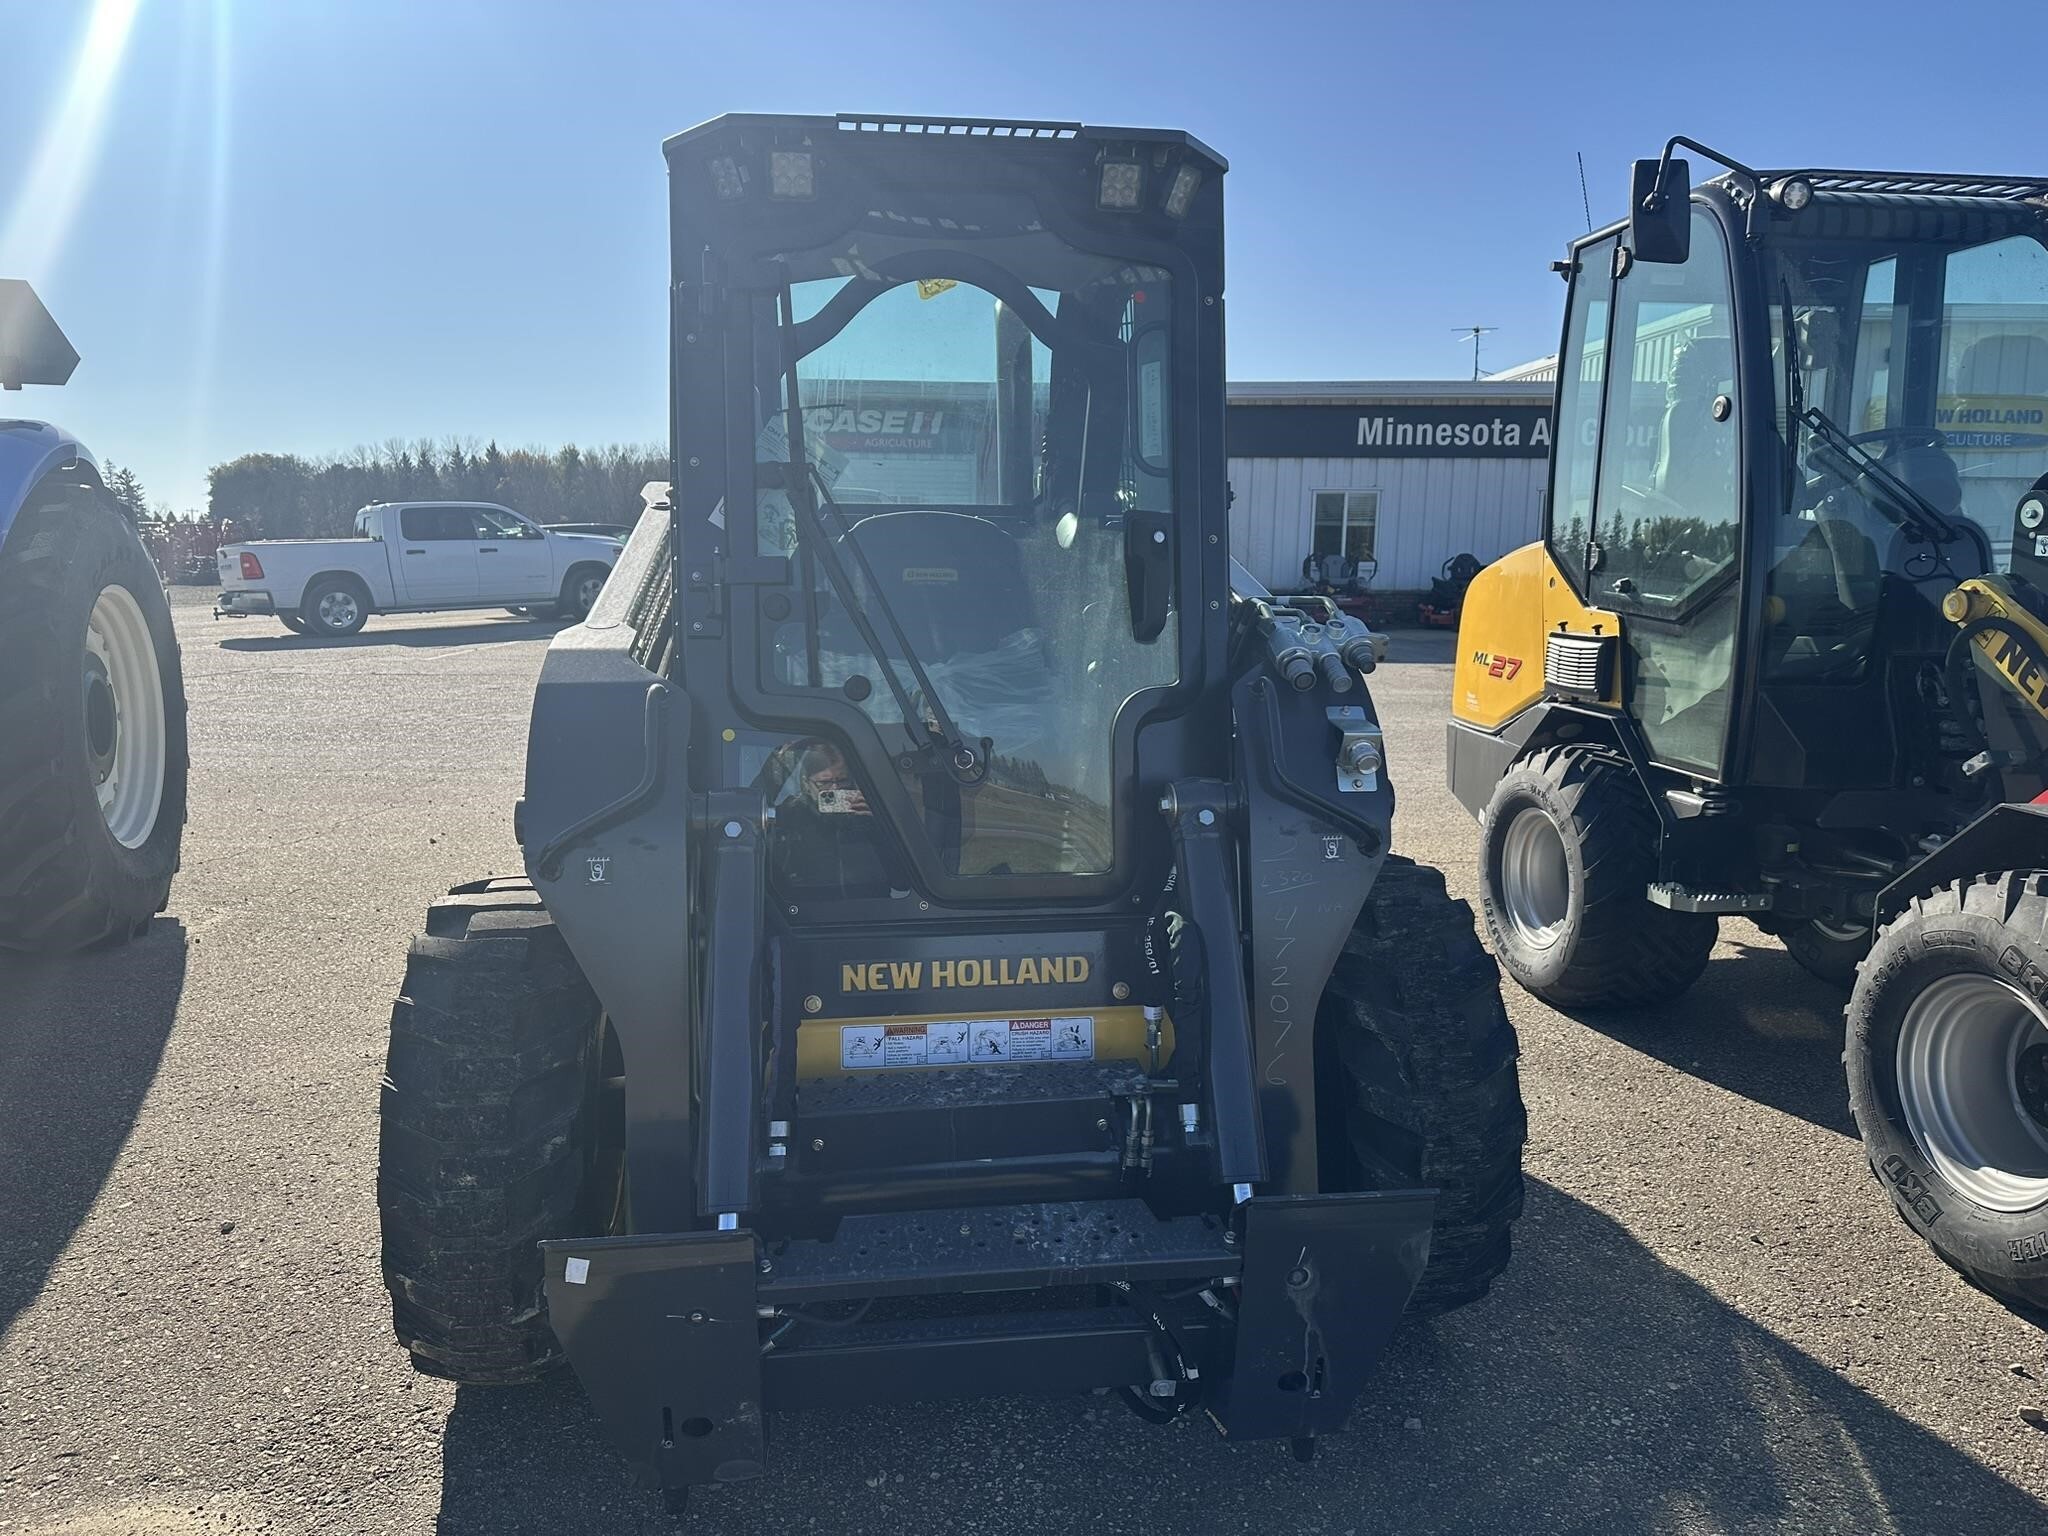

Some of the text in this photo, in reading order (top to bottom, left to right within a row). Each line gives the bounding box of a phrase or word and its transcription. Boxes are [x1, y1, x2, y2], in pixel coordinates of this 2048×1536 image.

[806, 409, 907, 434] CASE
[1958, 409, 2044, 424] HOLLAND
[864, 438, 933, 448] AGRICULTURE
[1357, 417, 1520, 446] Minnesota
[842, 956, 1090, 992] NEW HOLLAND
[1998, 945, 2048, 1010] BK
[893, 1025, 926, 1035] WARNING
[1020, 1021, 1049, 1030] DANGER
[1881, 1155, 1944, 1227] BKT
